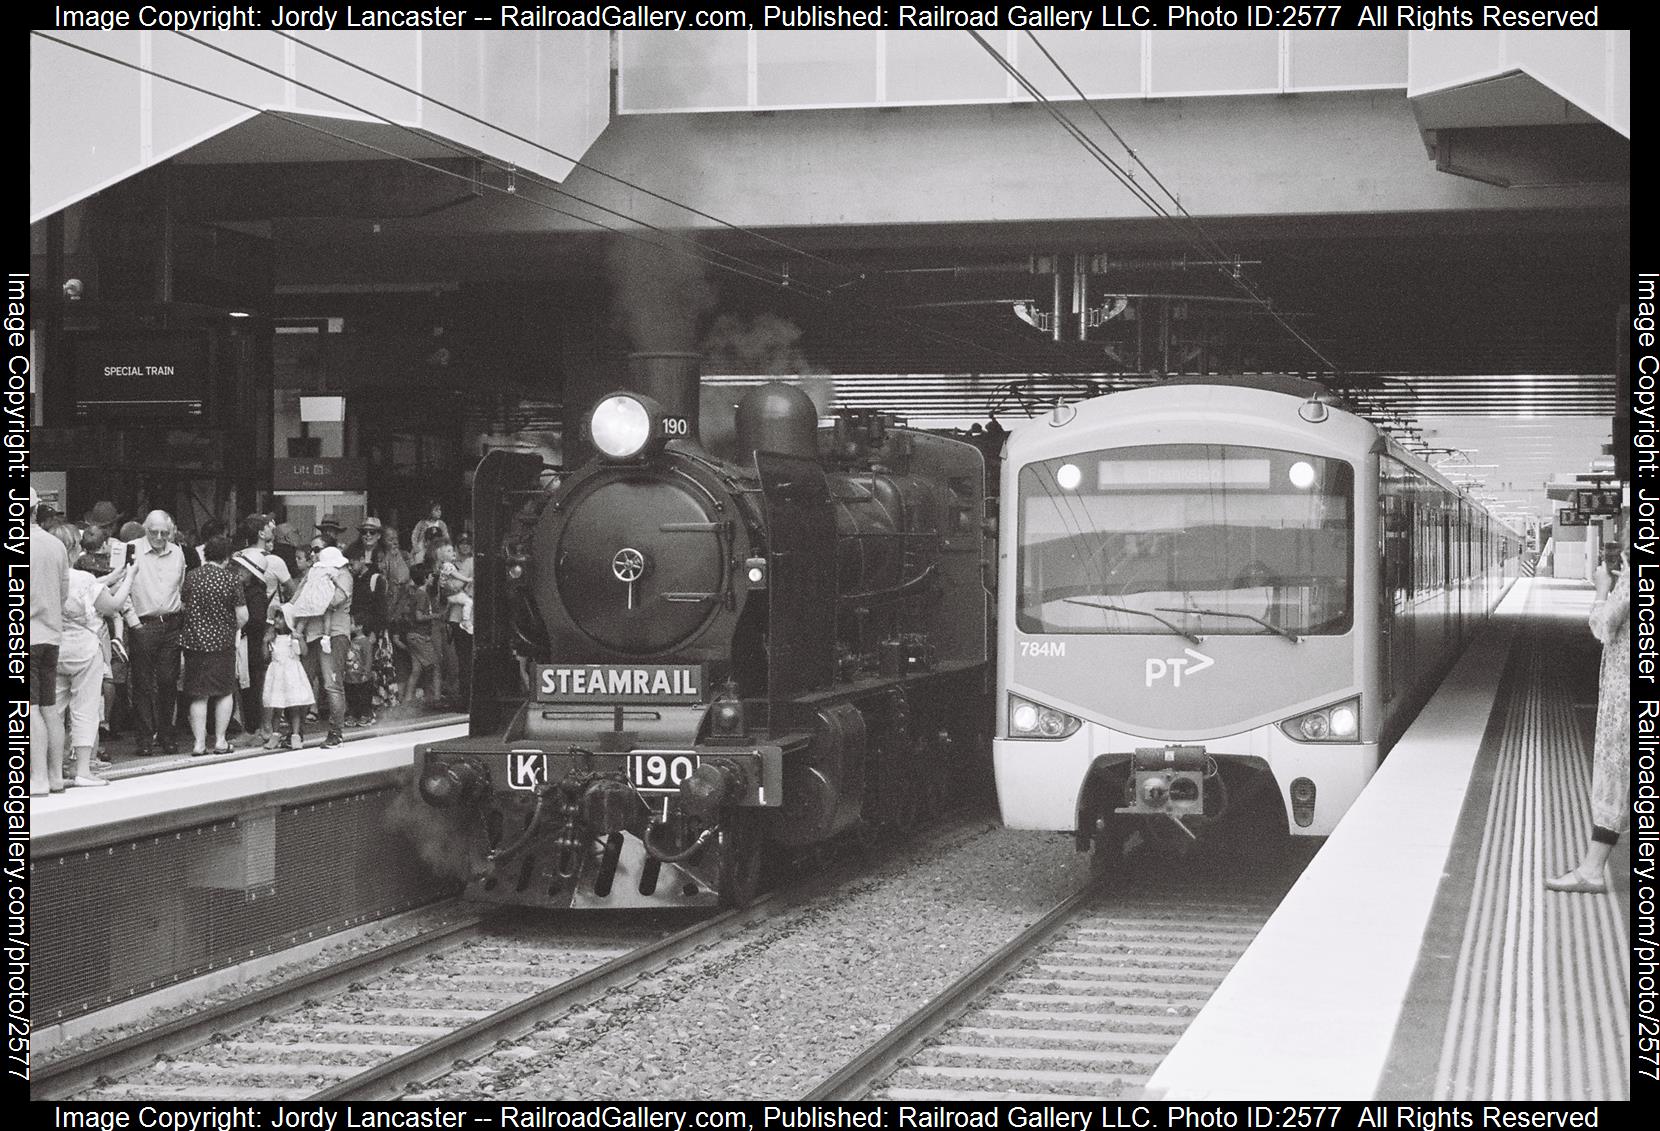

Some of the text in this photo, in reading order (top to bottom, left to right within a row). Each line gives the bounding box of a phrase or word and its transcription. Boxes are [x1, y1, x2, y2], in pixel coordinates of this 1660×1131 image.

[104, 366, 174, 376] SPECIAL TRAIN
[662, 418, 687, 435] 190
[1020, 642, 1066, 656] 784M
[541, 669, 697, 694] STEAMRAIL
[517, 754, 693, 786] K 190
